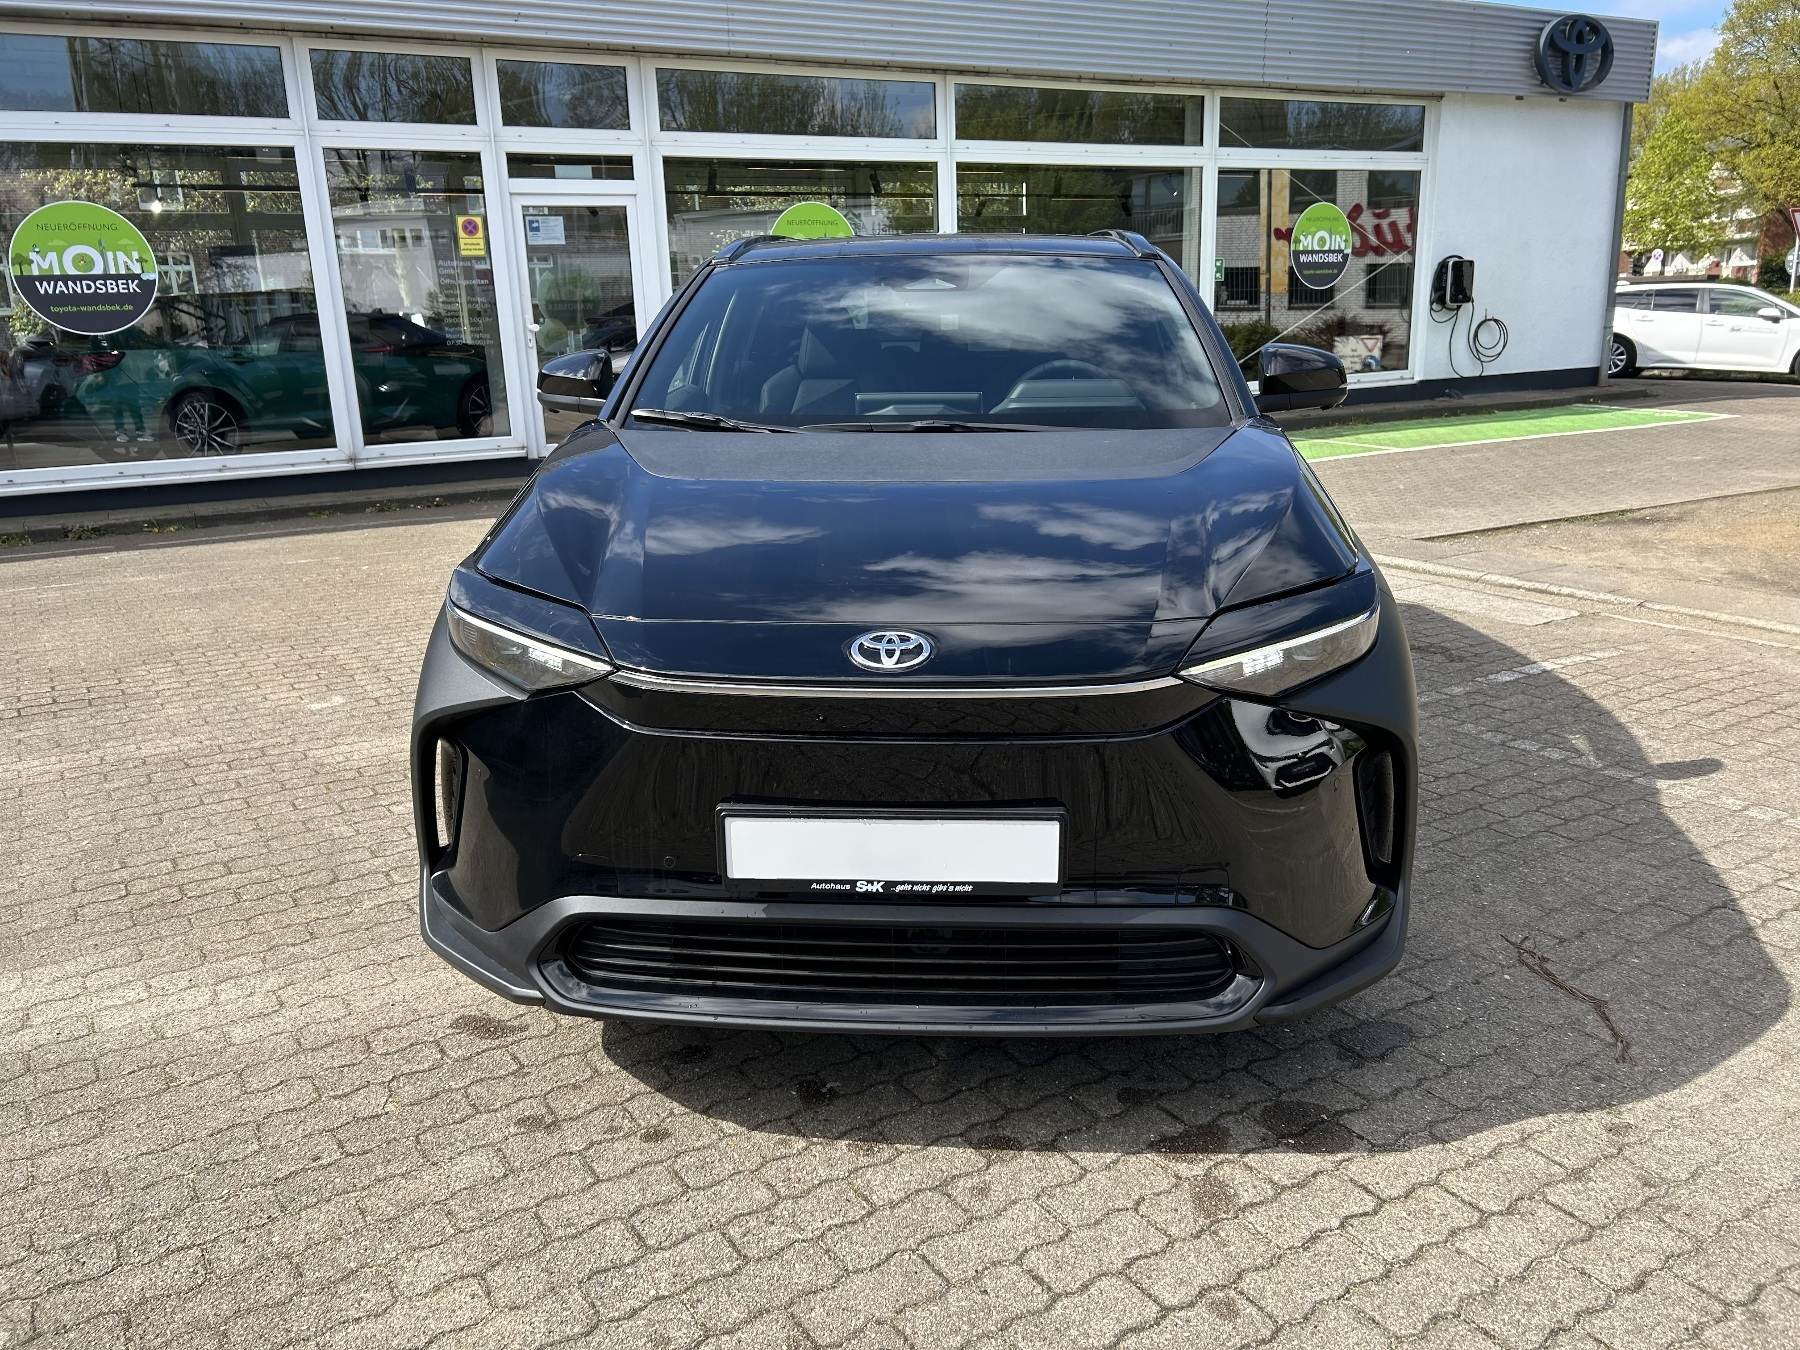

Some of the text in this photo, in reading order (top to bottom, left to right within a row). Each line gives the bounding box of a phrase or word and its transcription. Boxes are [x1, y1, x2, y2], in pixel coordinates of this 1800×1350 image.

[36, 222, 118, 231] NEUERÖFFNUNG
[786, 218, 839, 226] NEUERÖFFNUNG
[1300, 230, 1346, 251] MOIN
[29, 244, 142, 275] MOIN
[1299, 253, 1343, 263] WANDSBEK
[34, 279, 142, 294] WANDSBEK
[50, 303, 134, 314] toyota-wandsbek.de
[810, 882, 851, 890] Autohaus
[855, 880, 886, 892] S+K
